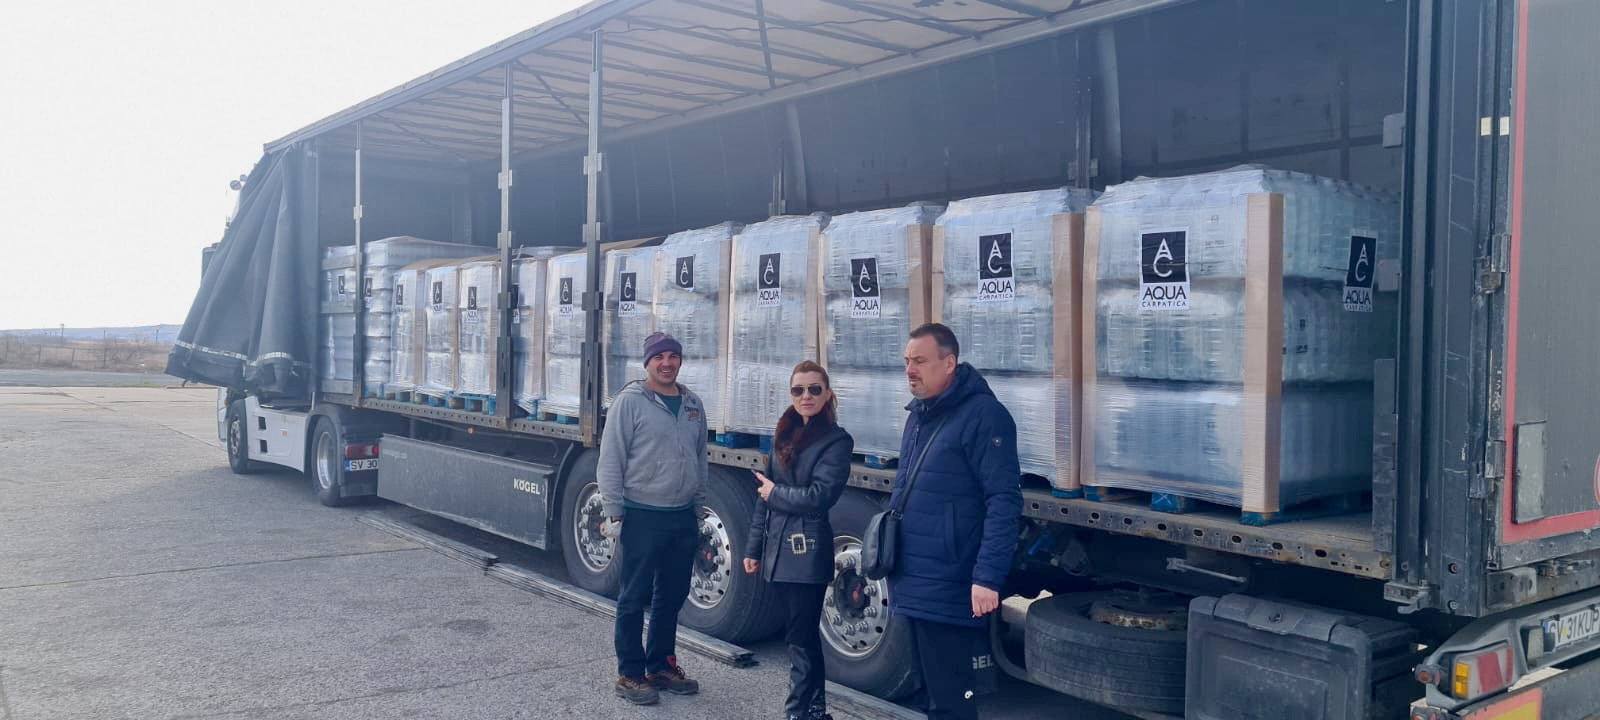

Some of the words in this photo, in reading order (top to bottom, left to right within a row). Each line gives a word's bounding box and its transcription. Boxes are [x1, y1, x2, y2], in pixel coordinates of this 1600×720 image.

[980, 280, 1013, 294] AQUA
[1143, 286, 1186, 300] AQUA
[760, 290, 779, 300] AQUA
[1345, 290, 1370, 304] AQUA
[854, 300, 878, 310] AQUA
[351, 461, 363, 470] SV
